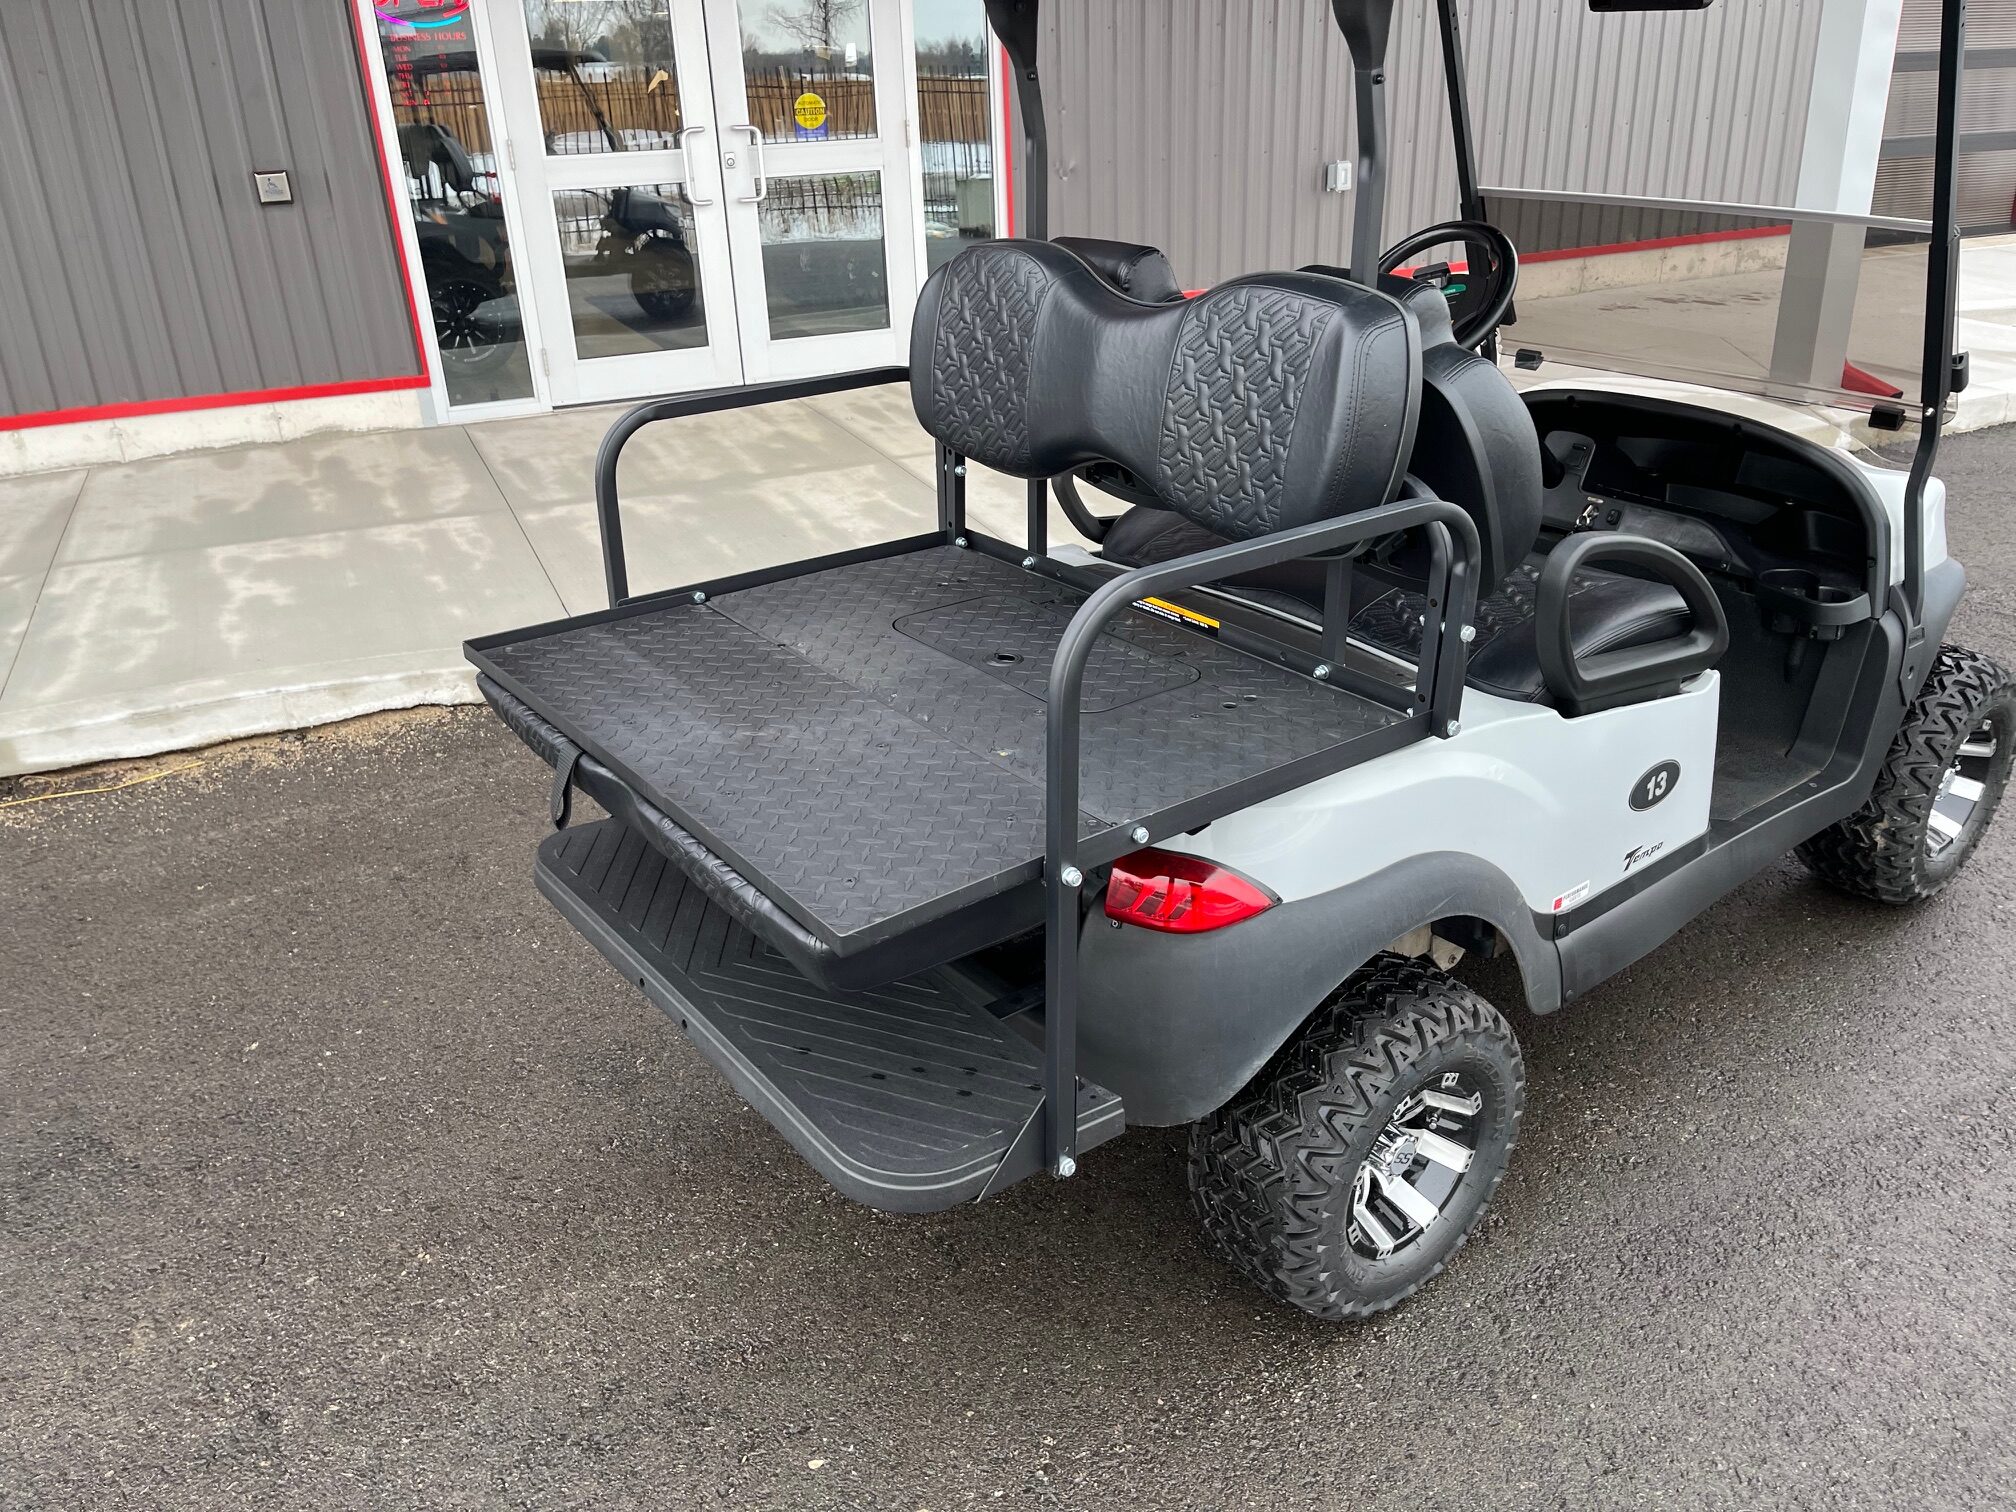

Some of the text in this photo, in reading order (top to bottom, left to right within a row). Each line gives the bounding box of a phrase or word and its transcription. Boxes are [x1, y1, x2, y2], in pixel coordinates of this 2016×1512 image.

[390, 32, 467, 42] BUSINESS HOURS
[796, 107, 825, 115] CAUTION
[1646, 770, 1668, 800] 13
[1623, 841, 1664, 872] Tempo
